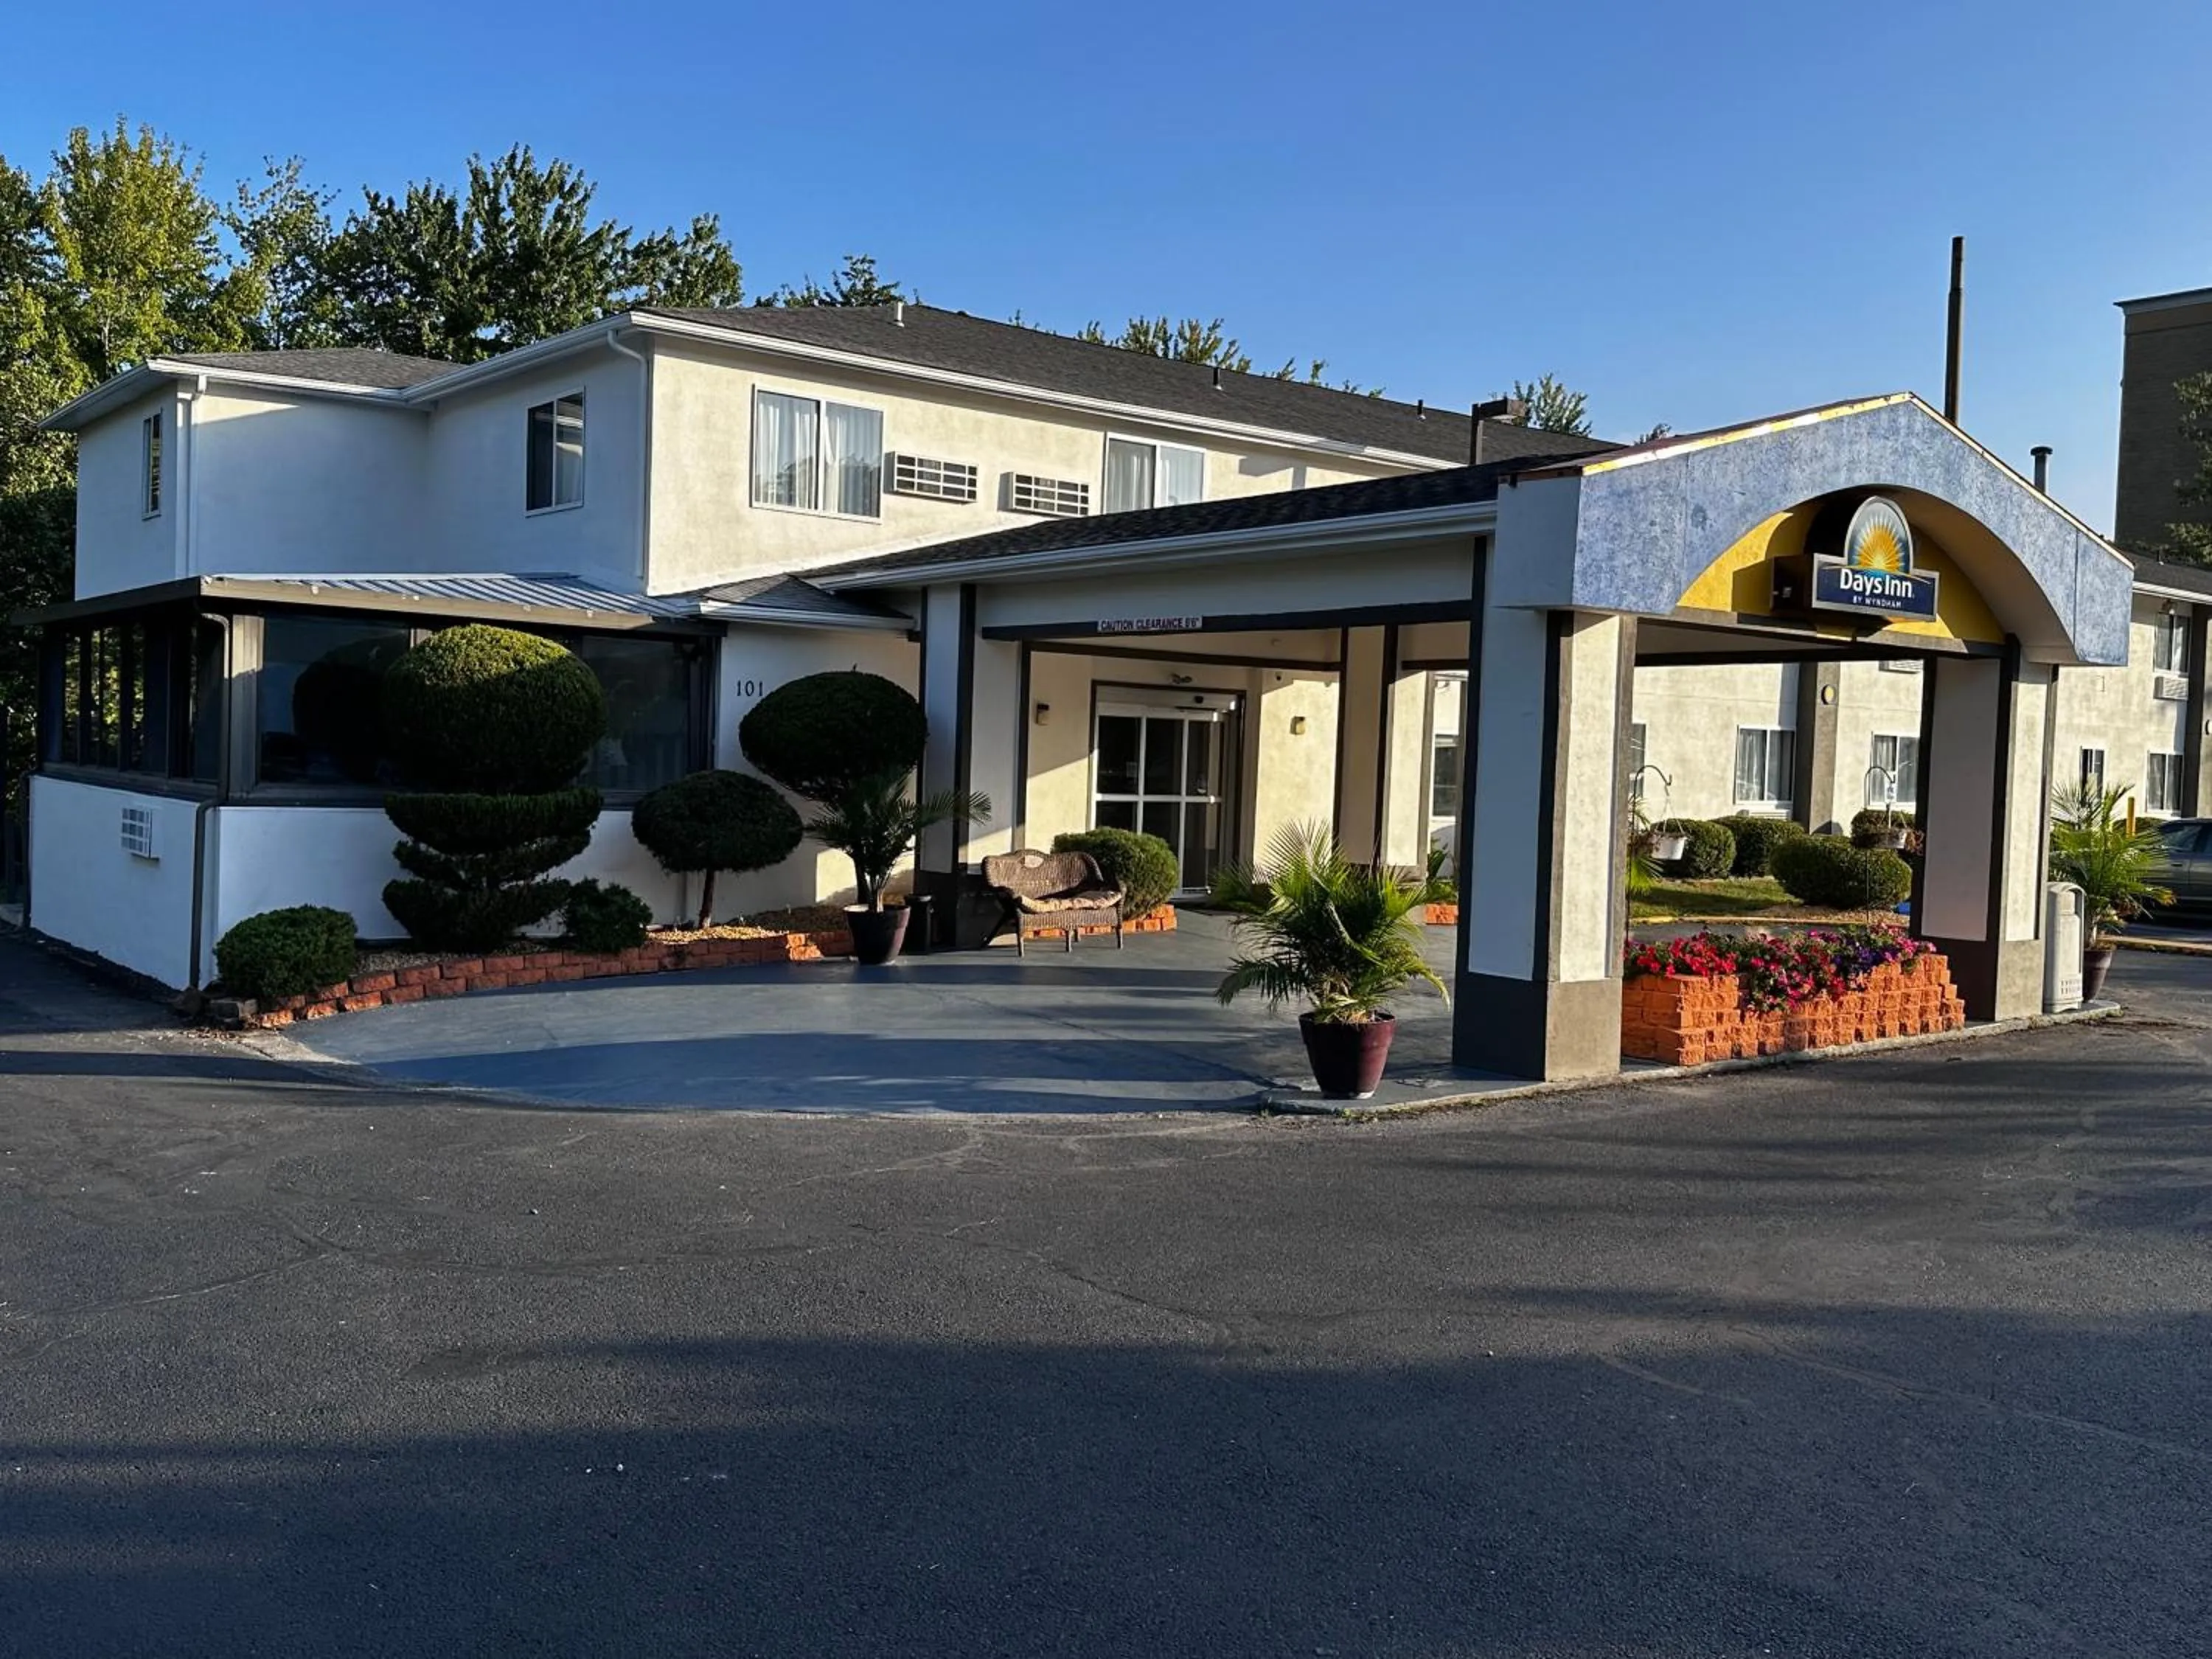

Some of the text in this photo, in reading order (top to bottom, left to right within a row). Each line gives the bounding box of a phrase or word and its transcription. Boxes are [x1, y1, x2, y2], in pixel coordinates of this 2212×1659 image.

[1840, 568, 1912, 598] Days Inn
[1853, 595, 1902, 608] BY WYNDHAM
[1101, 619, 1133, 632] CAUTION
[1136, 617, 1183, 629] CLEARANCE
[737, 680, 763, 697] 101
